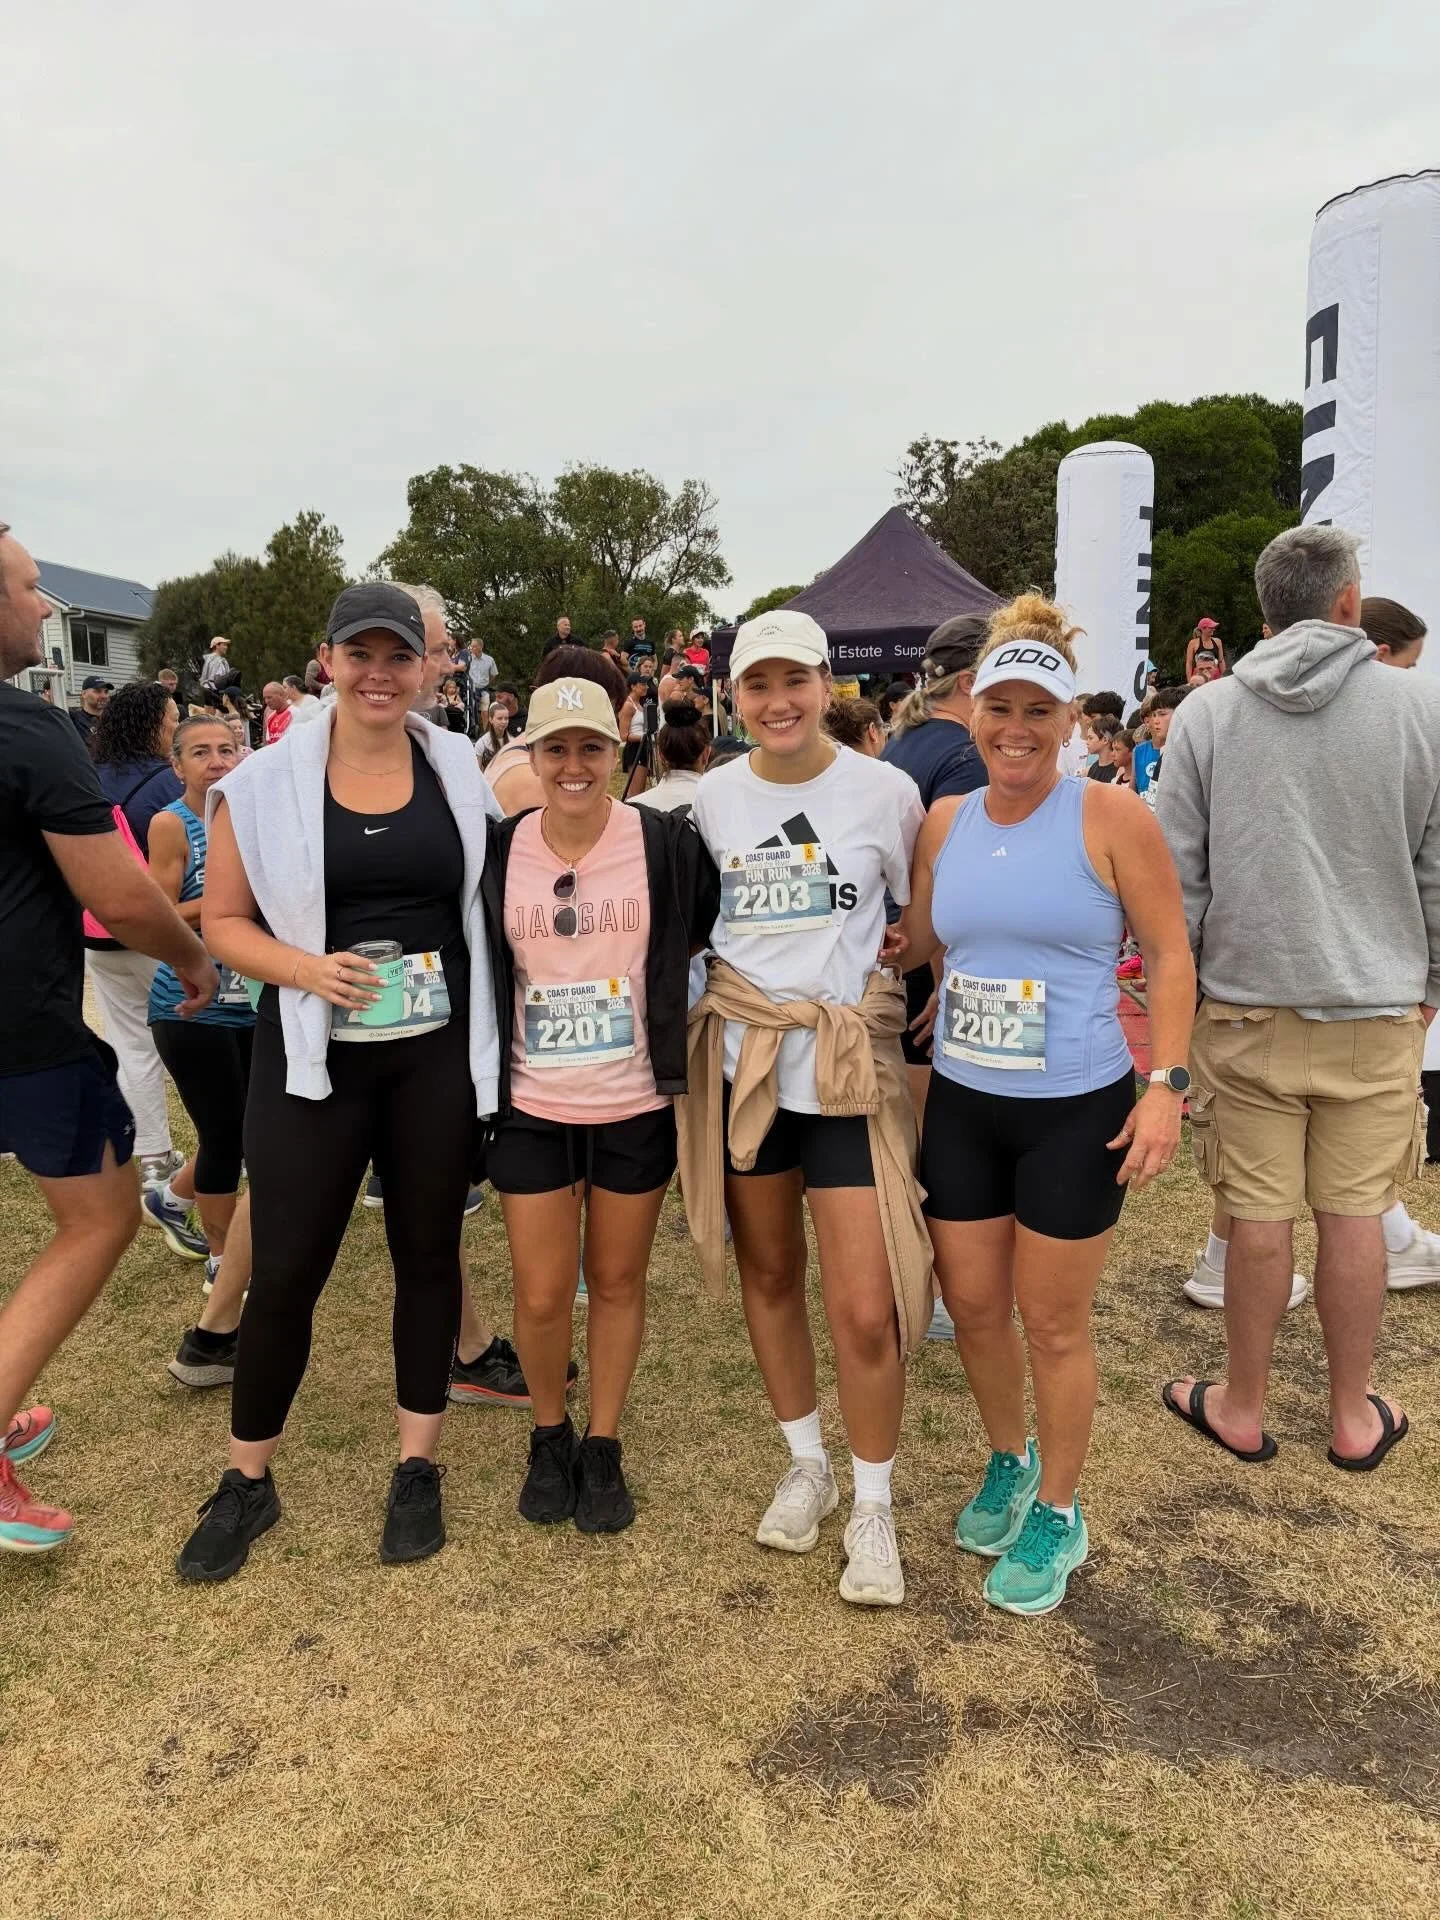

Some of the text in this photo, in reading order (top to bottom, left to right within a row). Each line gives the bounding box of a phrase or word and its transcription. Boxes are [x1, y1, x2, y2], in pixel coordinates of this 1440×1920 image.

[838, 645, 883, 659] Estate
[894, 645, 926, 659] Supp
[745, 850, 791, 863] COAST GUARD
[745, 863, 822, 883] FUN RUN 2026
[733, 880, 812, 916] 2203
[546, 985, 597, 999] COAST GUARD
[962, 979, 980, 991] COAST
[980, 982, 1007, 993] GUARD
[549, 998, 626, 1018] FUN RUN 2026
[962, 996, 1038, 1015] FUN RUN 2026
[536, 1013, 613, 1049] 2201
[952, 1008, 1024, 1050] 2202
